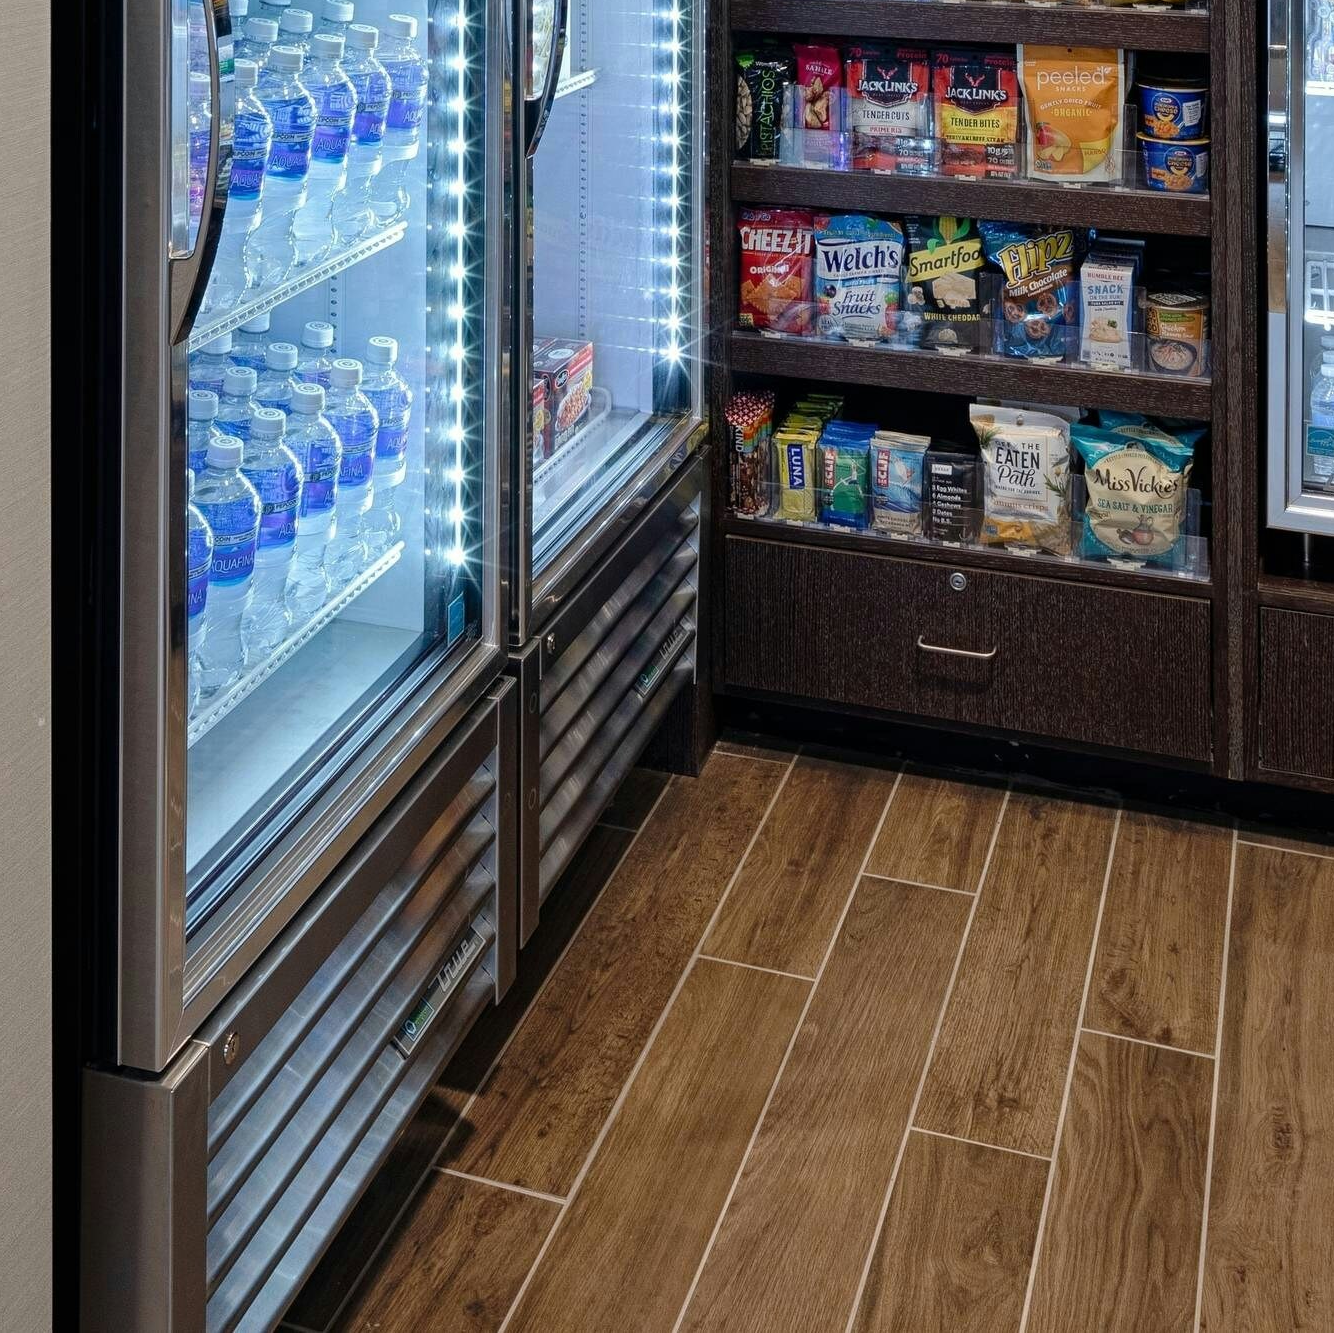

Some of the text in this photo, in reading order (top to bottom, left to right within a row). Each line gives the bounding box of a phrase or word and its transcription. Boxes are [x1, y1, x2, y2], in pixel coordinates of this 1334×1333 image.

[857, 80, 918, 93] JACK LINK'S
[1037, 66, 1107, 90] peeled
[945, 87, 1007, 101] JACK LINK'S
[1040, 99, 1063, 110] GENTLY
[863, 110, 910, 120] TENDER CUTS
[951, 118, 1000, 129] TENDER BITES
[822, 245, 899, 273] Welch's
[910, 246, 980, 276] Smartfoo
[999, 231, 1074, 288] Flipz
[1009, 284, 1029, 297] Milk
[1029, 269, 1068, 290] Chocolate
[1087, 272, 1111, 280] BUMBLE
[842, 289, 875, 304] Fruit
[1088, 284, 1123, 294] SNACK
[832, 301, 881, 316] Snacks
[924, 312, 945, 321] WHITE
[735, 425, 744, 452] KIND
[1022, 442, 1040, 451] THE
[790, 448, 803, 486] LUNA
[824, 450, 836, 478] CLIF
[878, 450, 890, 477] CLIF
[995, 447, 1040, 469] EATEN
[997, 465, 1036, 488] Path
[1094, 467, 1179, 499] Miss Vickie's
[1097, 498, 1173, 514] SEA SALT & VINEGAR
